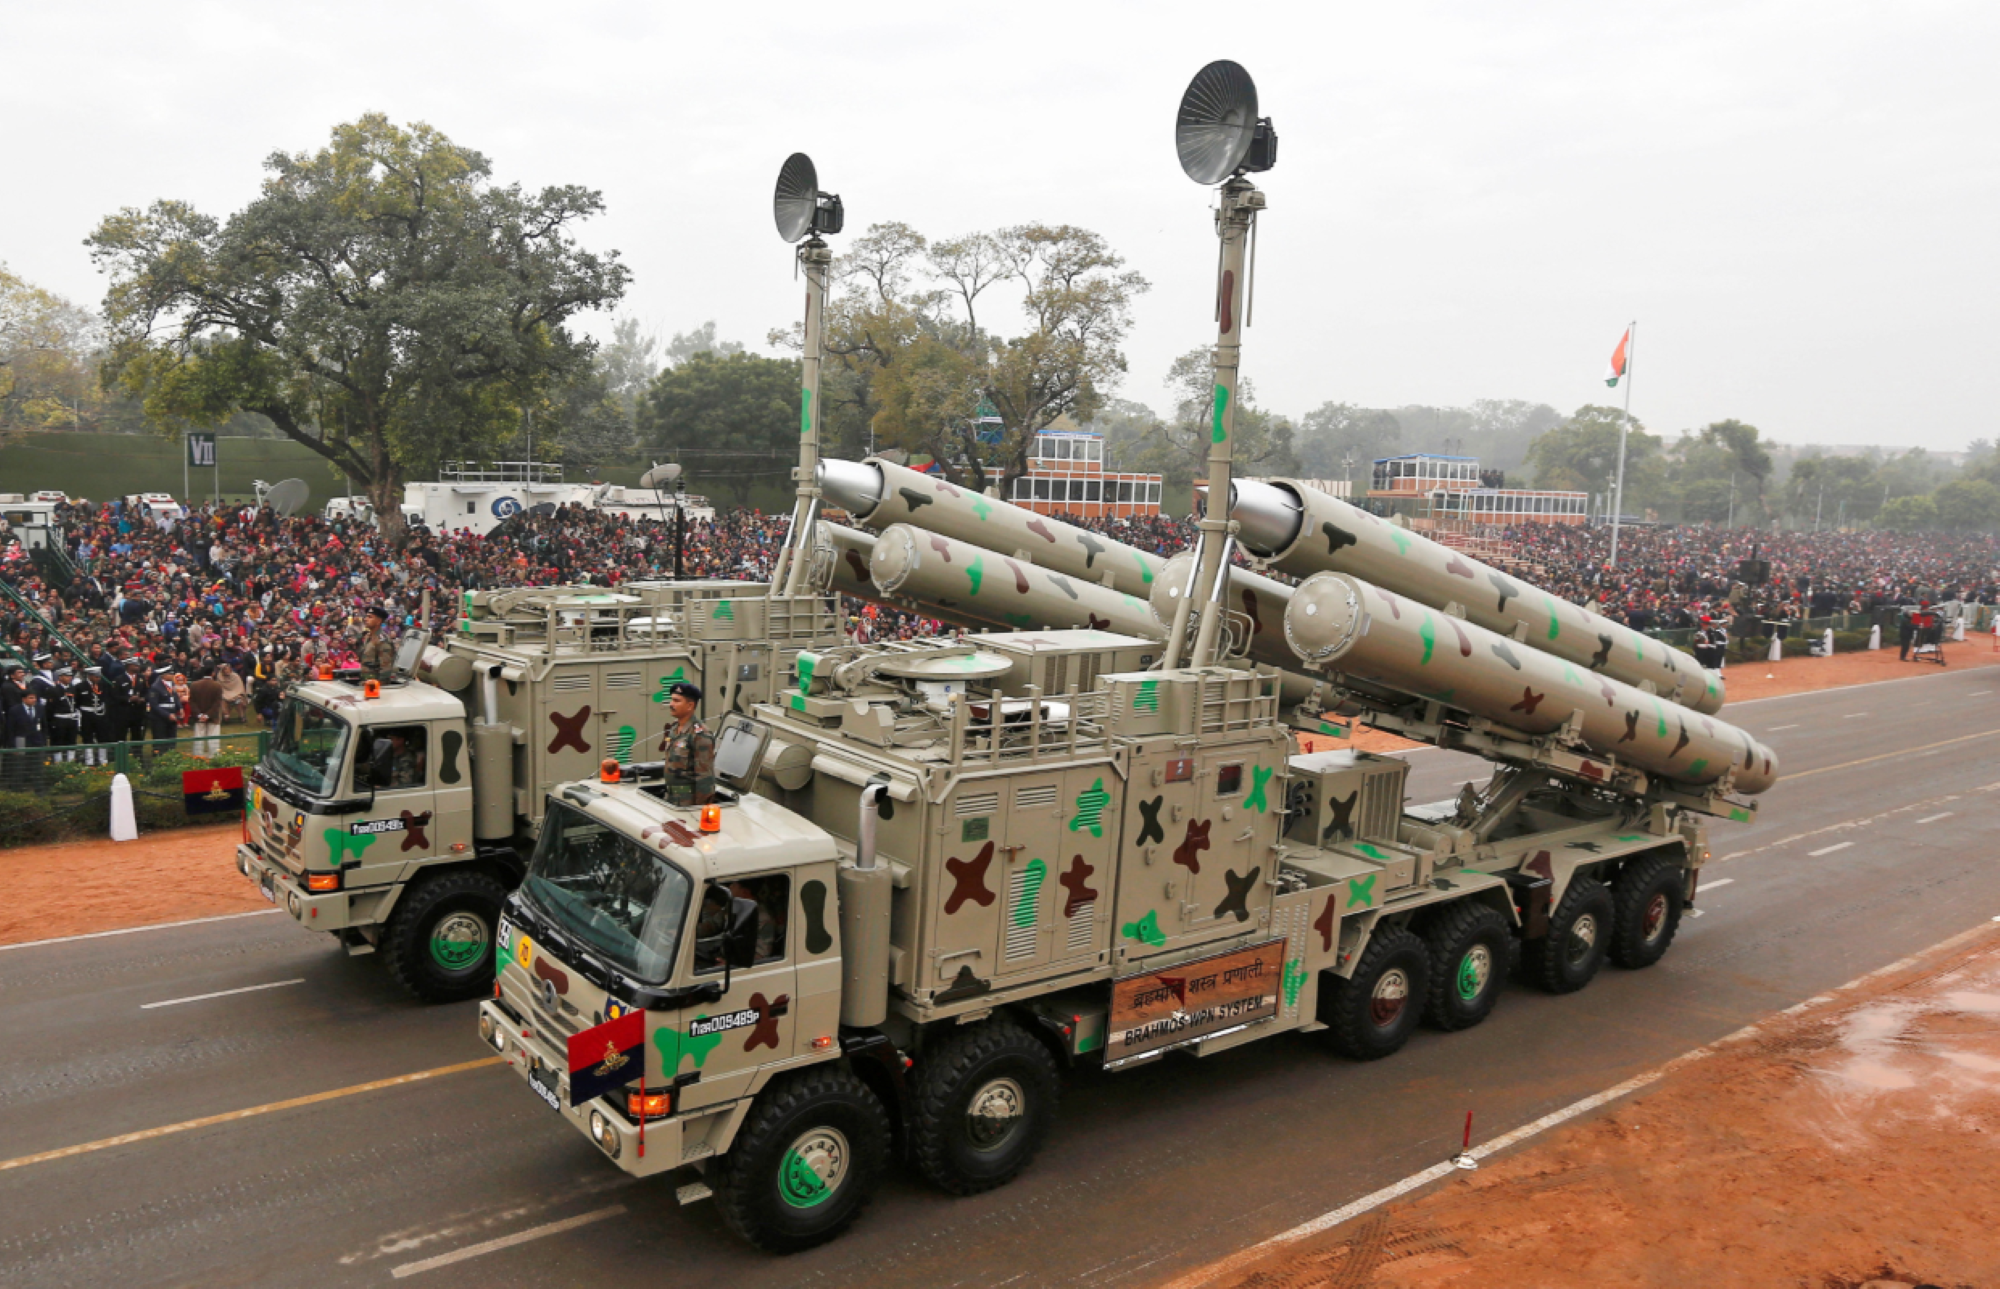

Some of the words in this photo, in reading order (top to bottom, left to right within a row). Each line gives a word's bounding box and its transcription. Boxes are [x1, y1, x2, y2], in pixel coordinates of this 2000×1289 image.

[190, 435, 214, 464] VII
[1222, 957, 1263, 985] प्रणाली
[1124, 1016, 1185, 1046] BRAHMOS
[1219, 994, 1263, 1019] SYSTEM
